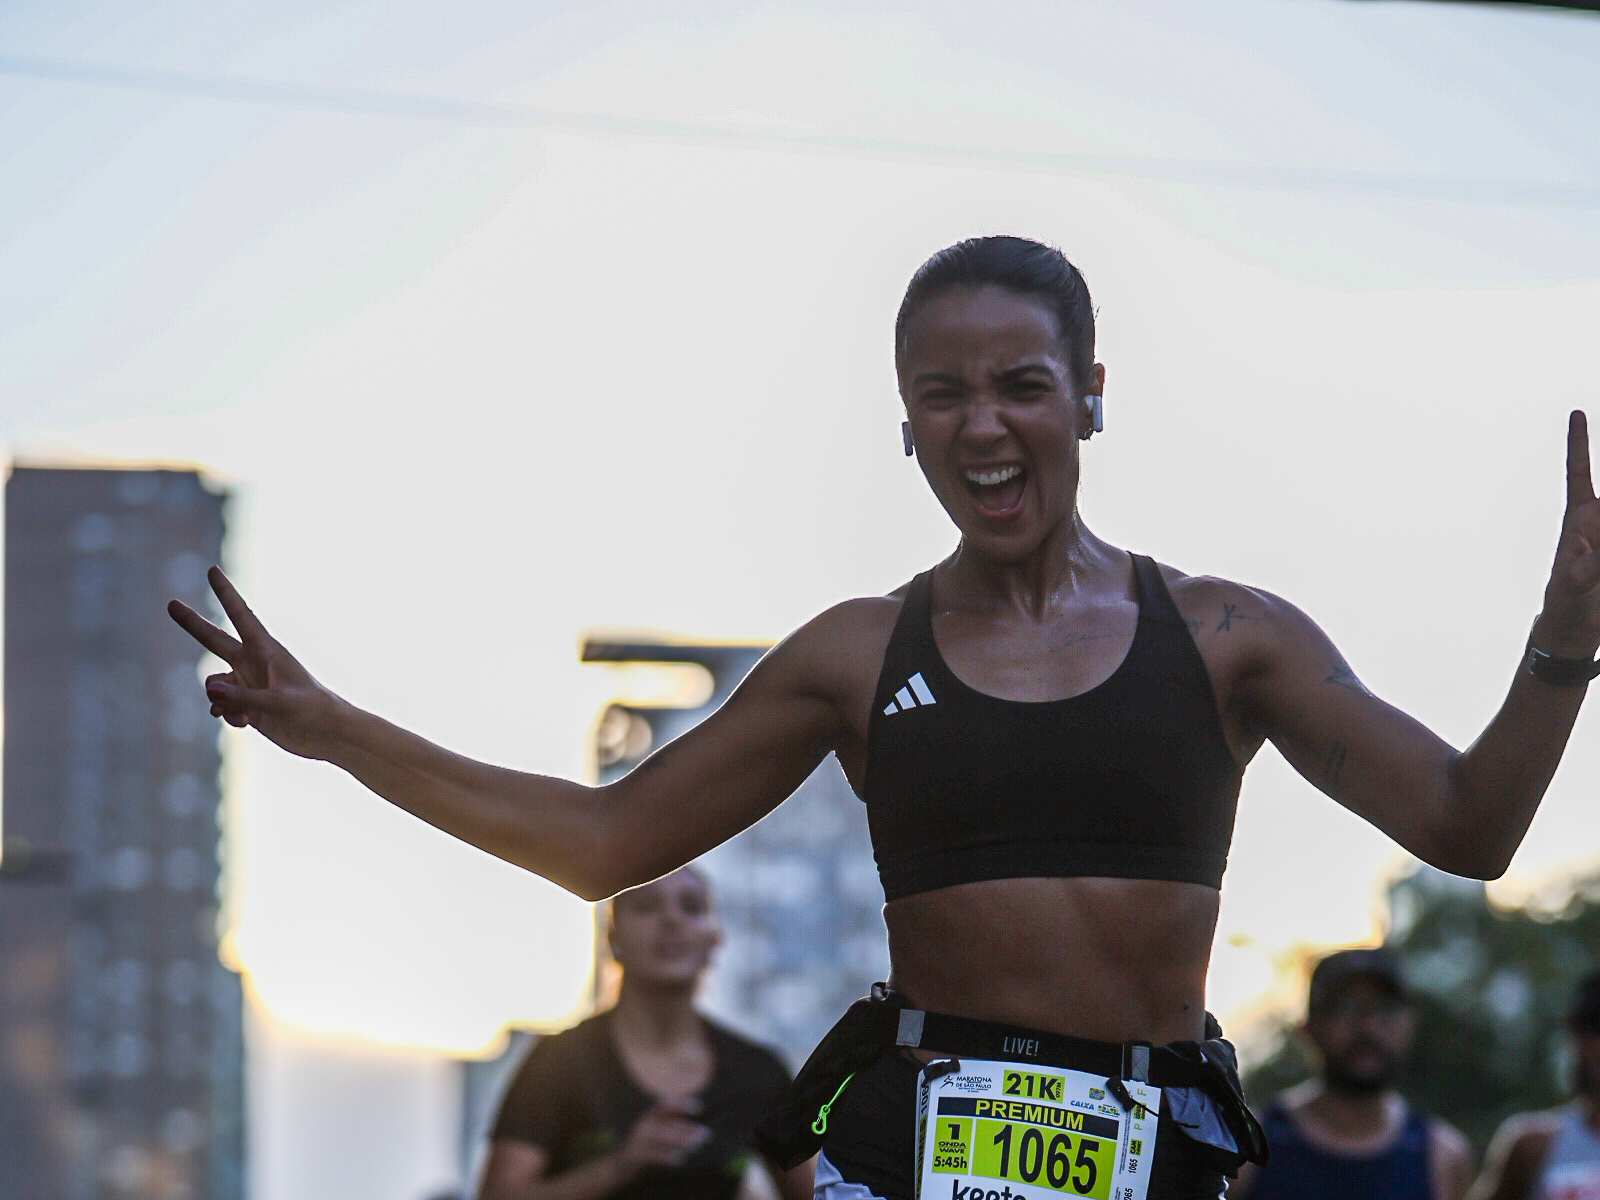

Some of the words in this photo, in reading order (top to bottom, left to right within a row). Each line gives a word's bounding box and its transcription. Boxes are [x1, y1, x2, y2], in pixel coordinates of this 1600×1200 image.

[1003, 1036, 1039, 1056] LIVE!
[956, 1075, 993, 1083] MARATONA
[1005, 1072, 1059, 1101] 21K
[1070, 1100, 1095, 1110] CAIXA
[975, 1099, 1084, 1131] PREMIUM
[947, 1123, 961, 1140] 1
[1130, 1140, 1138, 1155] CAM
[933, 1155, 968, 1169] 5:45h
[993, 1124, 1100, 1195] 1065
[1128, 1158, 1138, 1174] 1065
